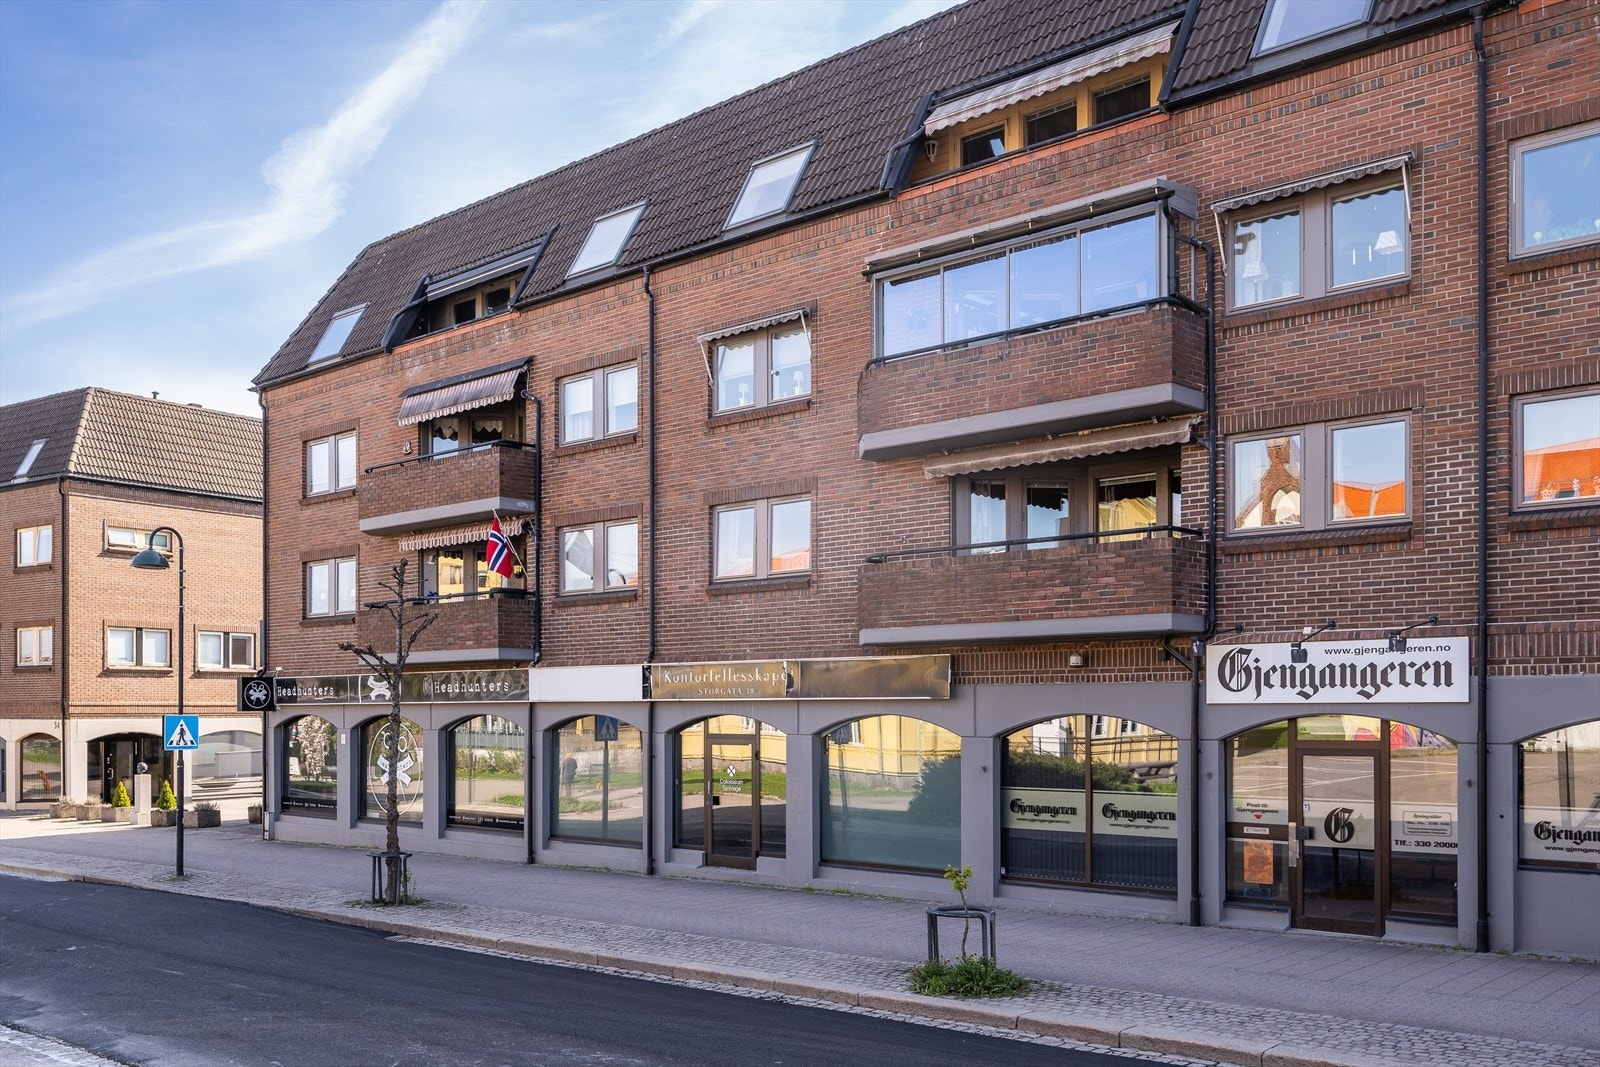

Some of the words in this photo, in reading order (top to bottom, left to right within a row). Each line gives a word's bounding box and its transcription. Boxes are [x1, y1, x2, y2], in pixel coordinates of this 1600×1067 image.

[1324, 644, 1451, 656] www.gjengaeren.no
[1218, 647, 1454, 701] Gjengangeren
[277, 686, 334, 696] Headhunters
[435, 681, 509, 693] Headhunters
[698, 688, 742, 696] STORGATA
[1009, 798, 1078, 817] Gjengangeren
[1102, 803, 1177, 822] Gjengangeren
[1413, 840, 1431, 848] 330
